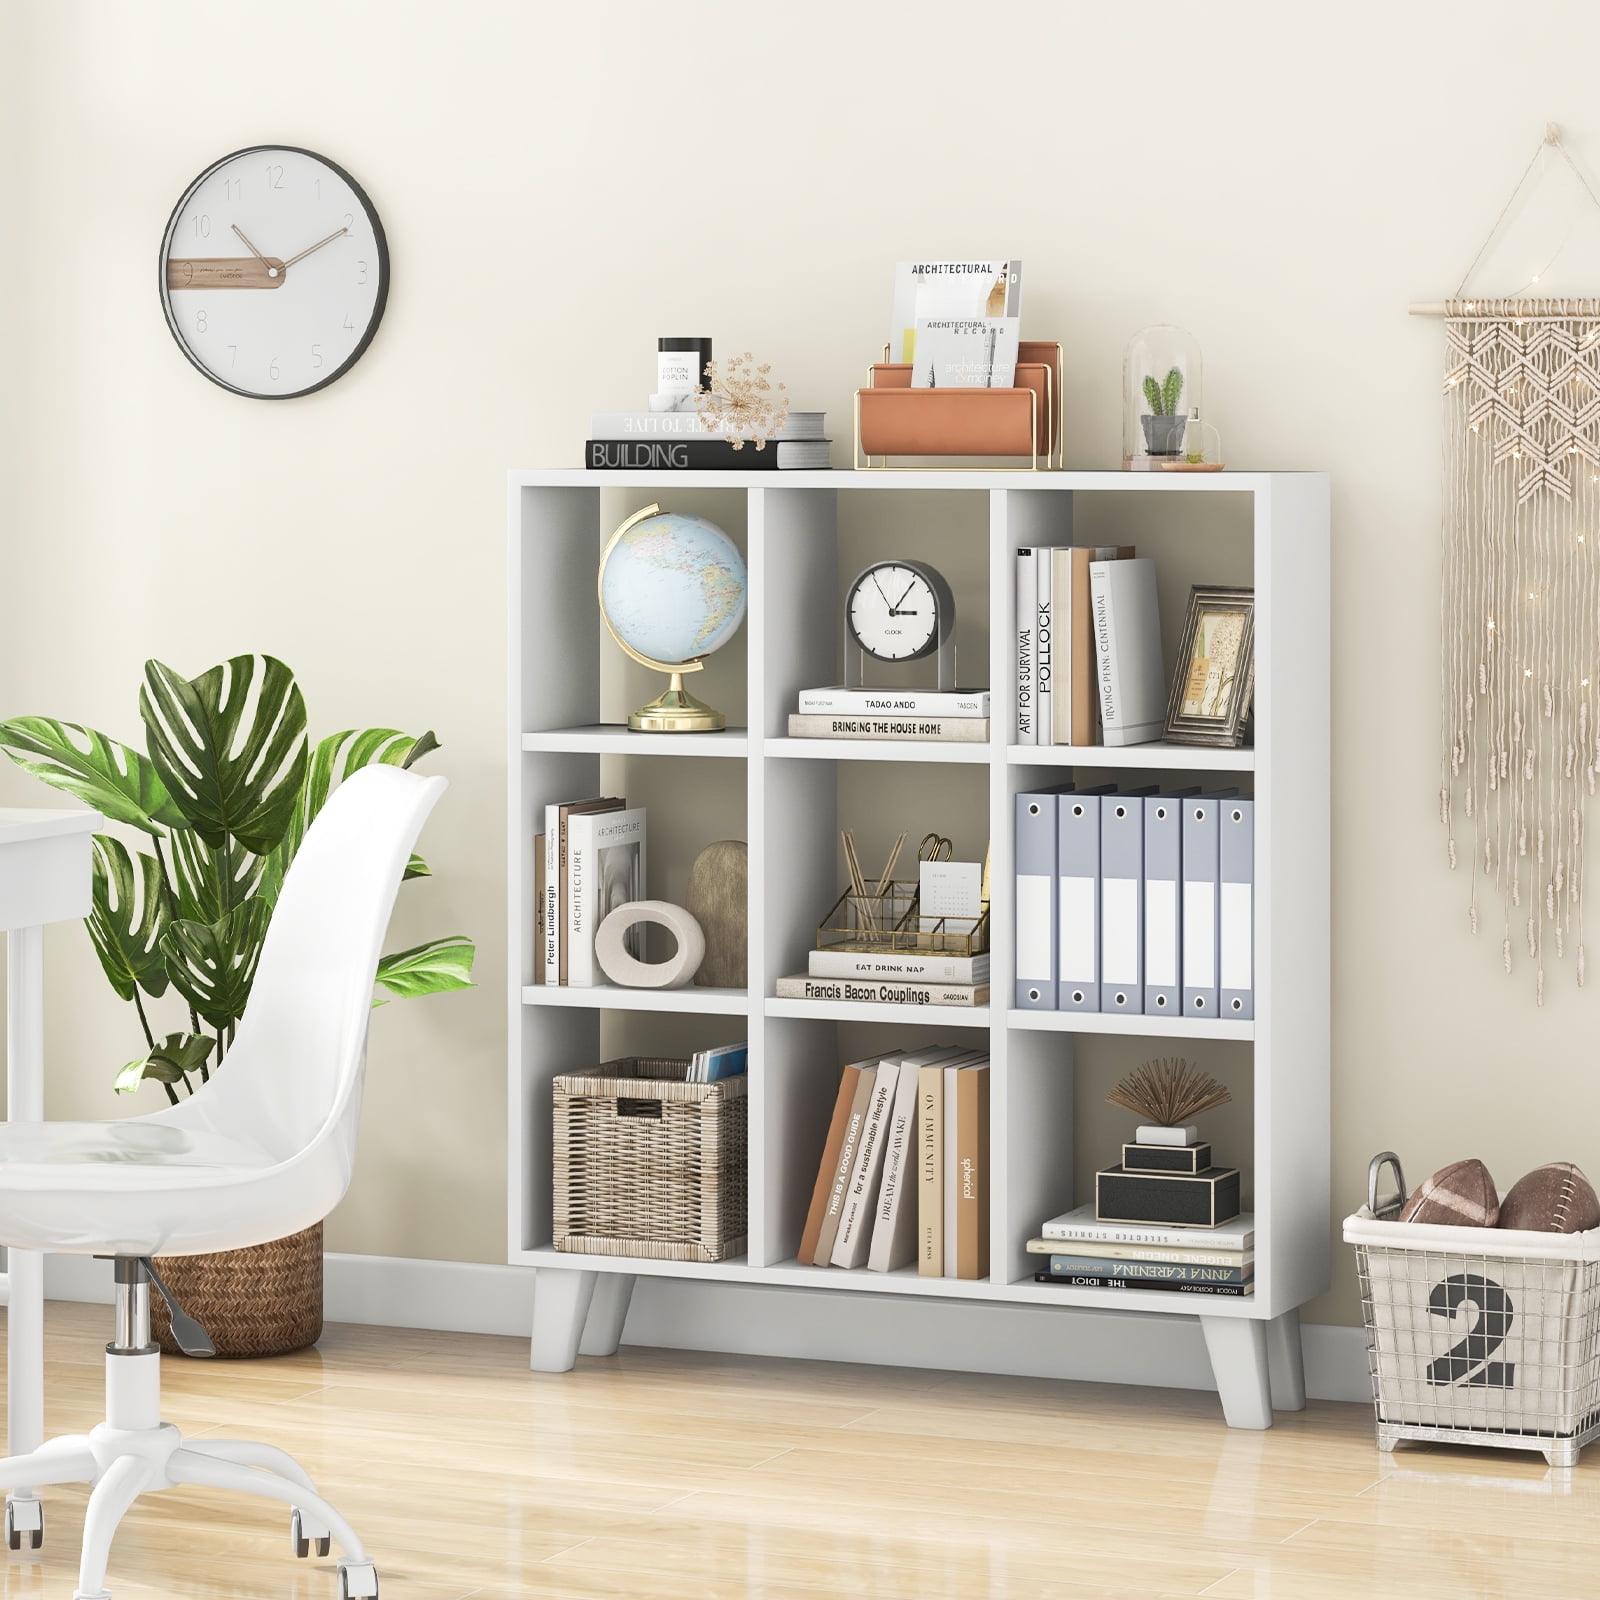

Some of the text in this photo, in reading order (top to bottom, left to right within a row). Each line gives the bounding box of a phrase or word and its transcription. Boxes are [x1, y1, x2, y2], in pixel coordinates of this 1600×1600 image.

[266, 166, 285, 188] 12
[224, 179, 241, 200] 11
[314, 179, 320, 200] 1
[192, 215, 210, 238] 10
[343, 214, 354, 237] 2
[184, 262, 193, 286] 9
[358, 261, 368, 284] 3
[912, 264, 992, 274] ARCHITECTURAL
[196, 310, 207, 333] 8
[343, 312, 354, 332] 4
[227, 345, 236, 368] 7
[312, 344, 323, 368] 5
[269, 357, 279, 380] 6
[624, 417, 657, 433] LIVE
[663, 417, 682, 433] TO
[592, 444, 688, 468] BUILDING
[1096, 594, 1109, 650] CENTENNIAL
[1039, 602, 1051, 693] POLLOCK
[1019, 629, 1031, 734] ART FOR SURVIVAL
[866, 700, 891, 709] TADAO
[894, 701, 916, 709] ANDO
[1103, 686, 1114, 720] IRVING
[832, 722, 941, 734] BRINGING THE HOUSE HOME
[598, 822, 640, 837] ARCHITECTURE
[573, 849, 582, 932] ARCHITECTURE
[547, 886, 557, 936] Lindbergh
[805, 983, 840, 998] Francis
[845, 984, 876, 1000] Bacon
[879, 986, 930, 1005] Couplings
[873, 1086, 887, 1122] lifestyle
[861, 1123, 877, 1171] sustainable
[926, 1094, 936, 1184] ON IMMUNITY
[829, 1113, 861, 1216] THIS IS A GOOD GUIDE
[859, 1172, 865, 1180] a
[882, 1184, 895, 1221] DREAM
[889, 1170, 897, 1183] the
[893, 1115, 907, 1150] AWAKE
[854, 1180, 864, 1195] for
[961, 1158, 975, 1200] spherical
[1060, 1230, 1168, 1242] SELECTED STORIES
[1133, 1251, 1232, 1264] EUGENE ONEGIN
[1072, 1276, 1100, 1287] IDIOT
[1113, 1264, 1186, 1279] KARENINA
[1191, 1267, 1233, 1280] ANNA
[1107, 1279, 1126, 1288] THE
[1426, 1273, 1515, 1389] 2
